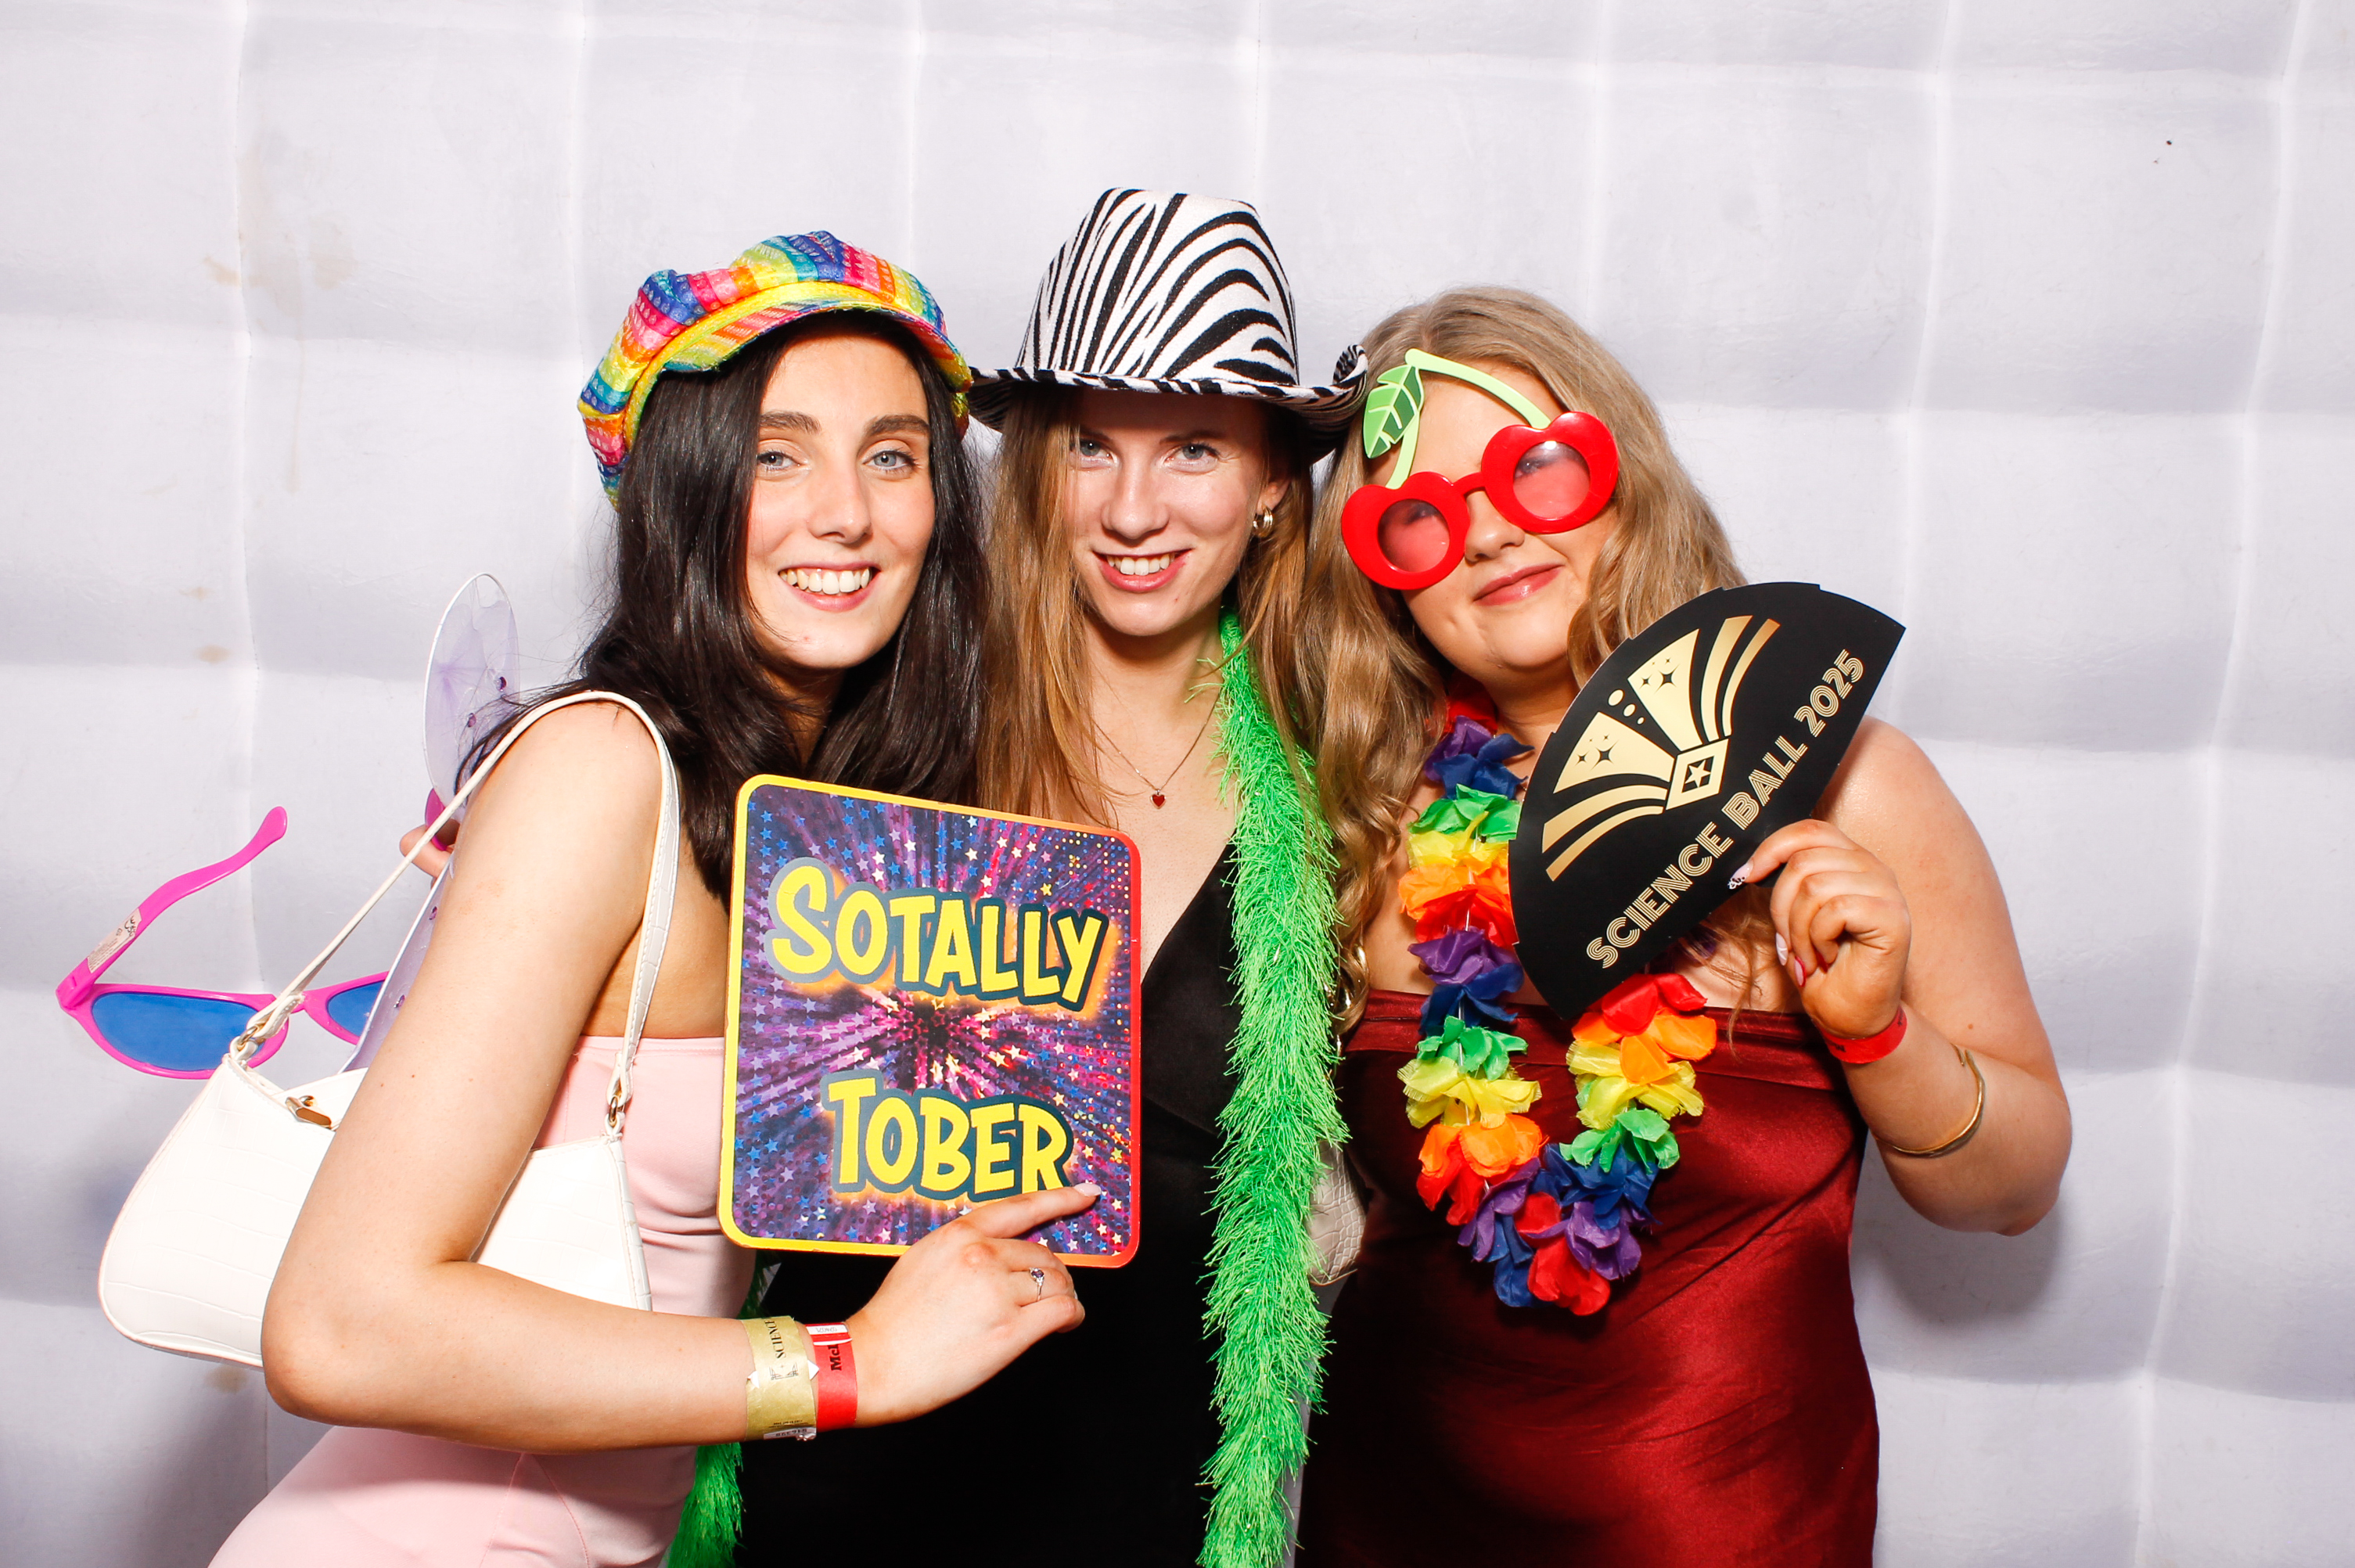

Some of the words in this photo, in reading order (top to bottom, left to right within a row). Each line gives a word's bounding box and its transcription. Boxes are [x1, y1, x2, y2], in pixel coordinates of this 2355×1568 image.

[1586, 821, 1734, 969] SCIENCE
[1721, 735, 1808, 830] BALL
[1793, 649, 1864, 738] 2025
[771, 863, 1103, 1004] SOTALLY
[826, 1077, 1069, 1195] TOBER
[764, 1319, 786, 1359] SCIENCE
